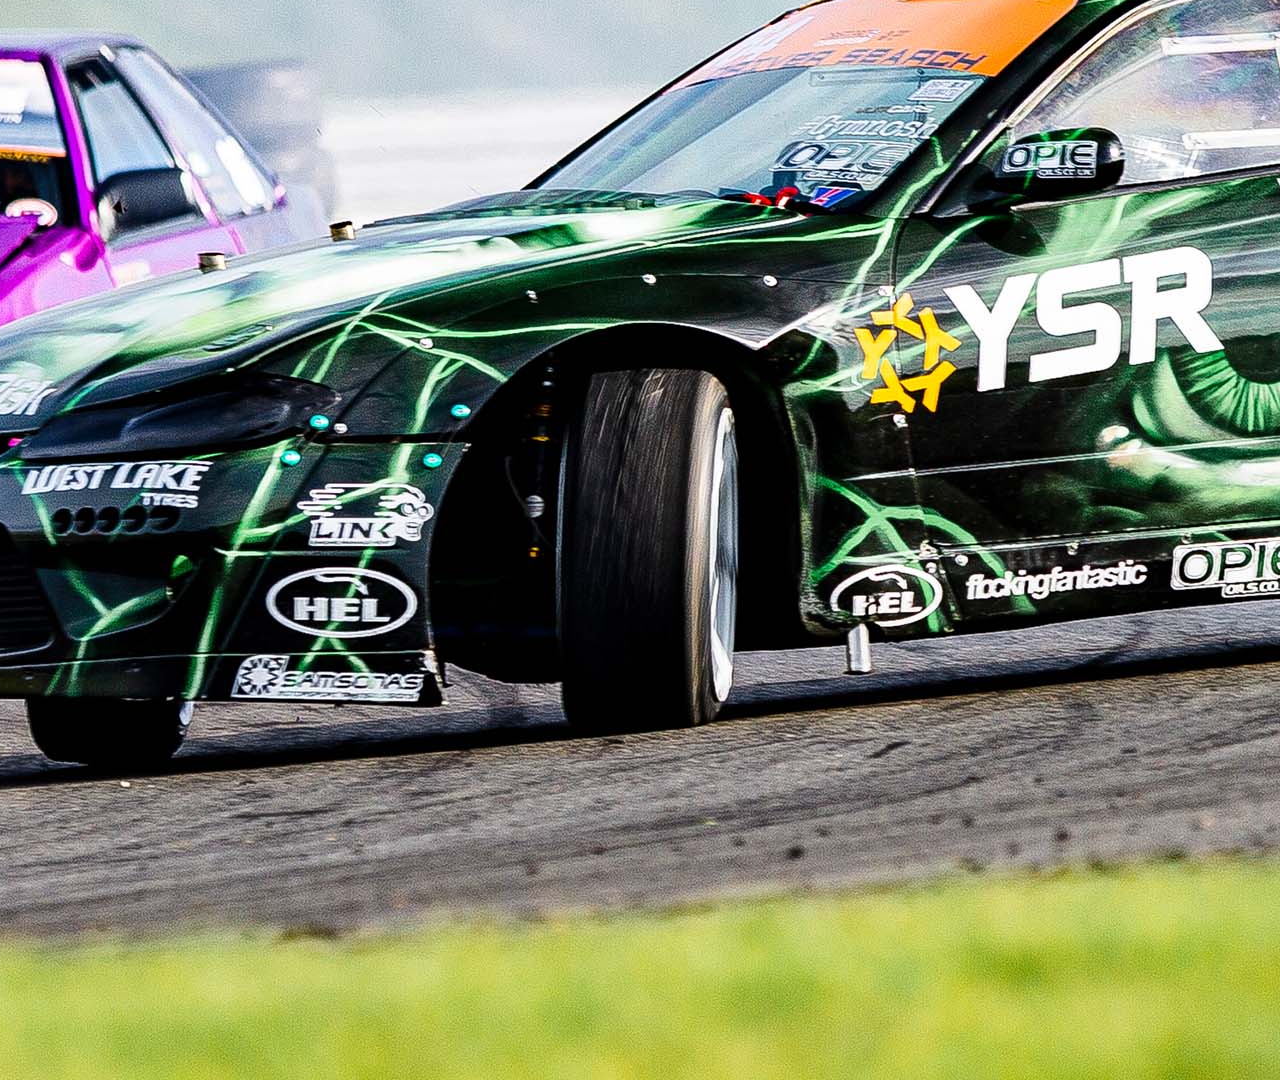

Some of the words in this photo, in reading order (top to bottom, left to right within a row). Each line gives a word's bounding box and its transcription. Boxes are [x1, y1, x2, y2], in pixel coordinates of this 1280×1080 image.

[837, 48, 988, 74] SEARCH
[1007, 144, 1094, 168] OPIE
[943, 246, 1224, 393] YSR
[21, 464, 114, 495] WEST
[110, 460, 214, 492] LAKE
[140, 492, 199, 509] TYRES
[315, 521, 395, 539] LINK
[966, 559, 1148, 601] flockingfantastic
[293, 597, 391, 623] HEL
[852, 592, 923, 617] HEL
